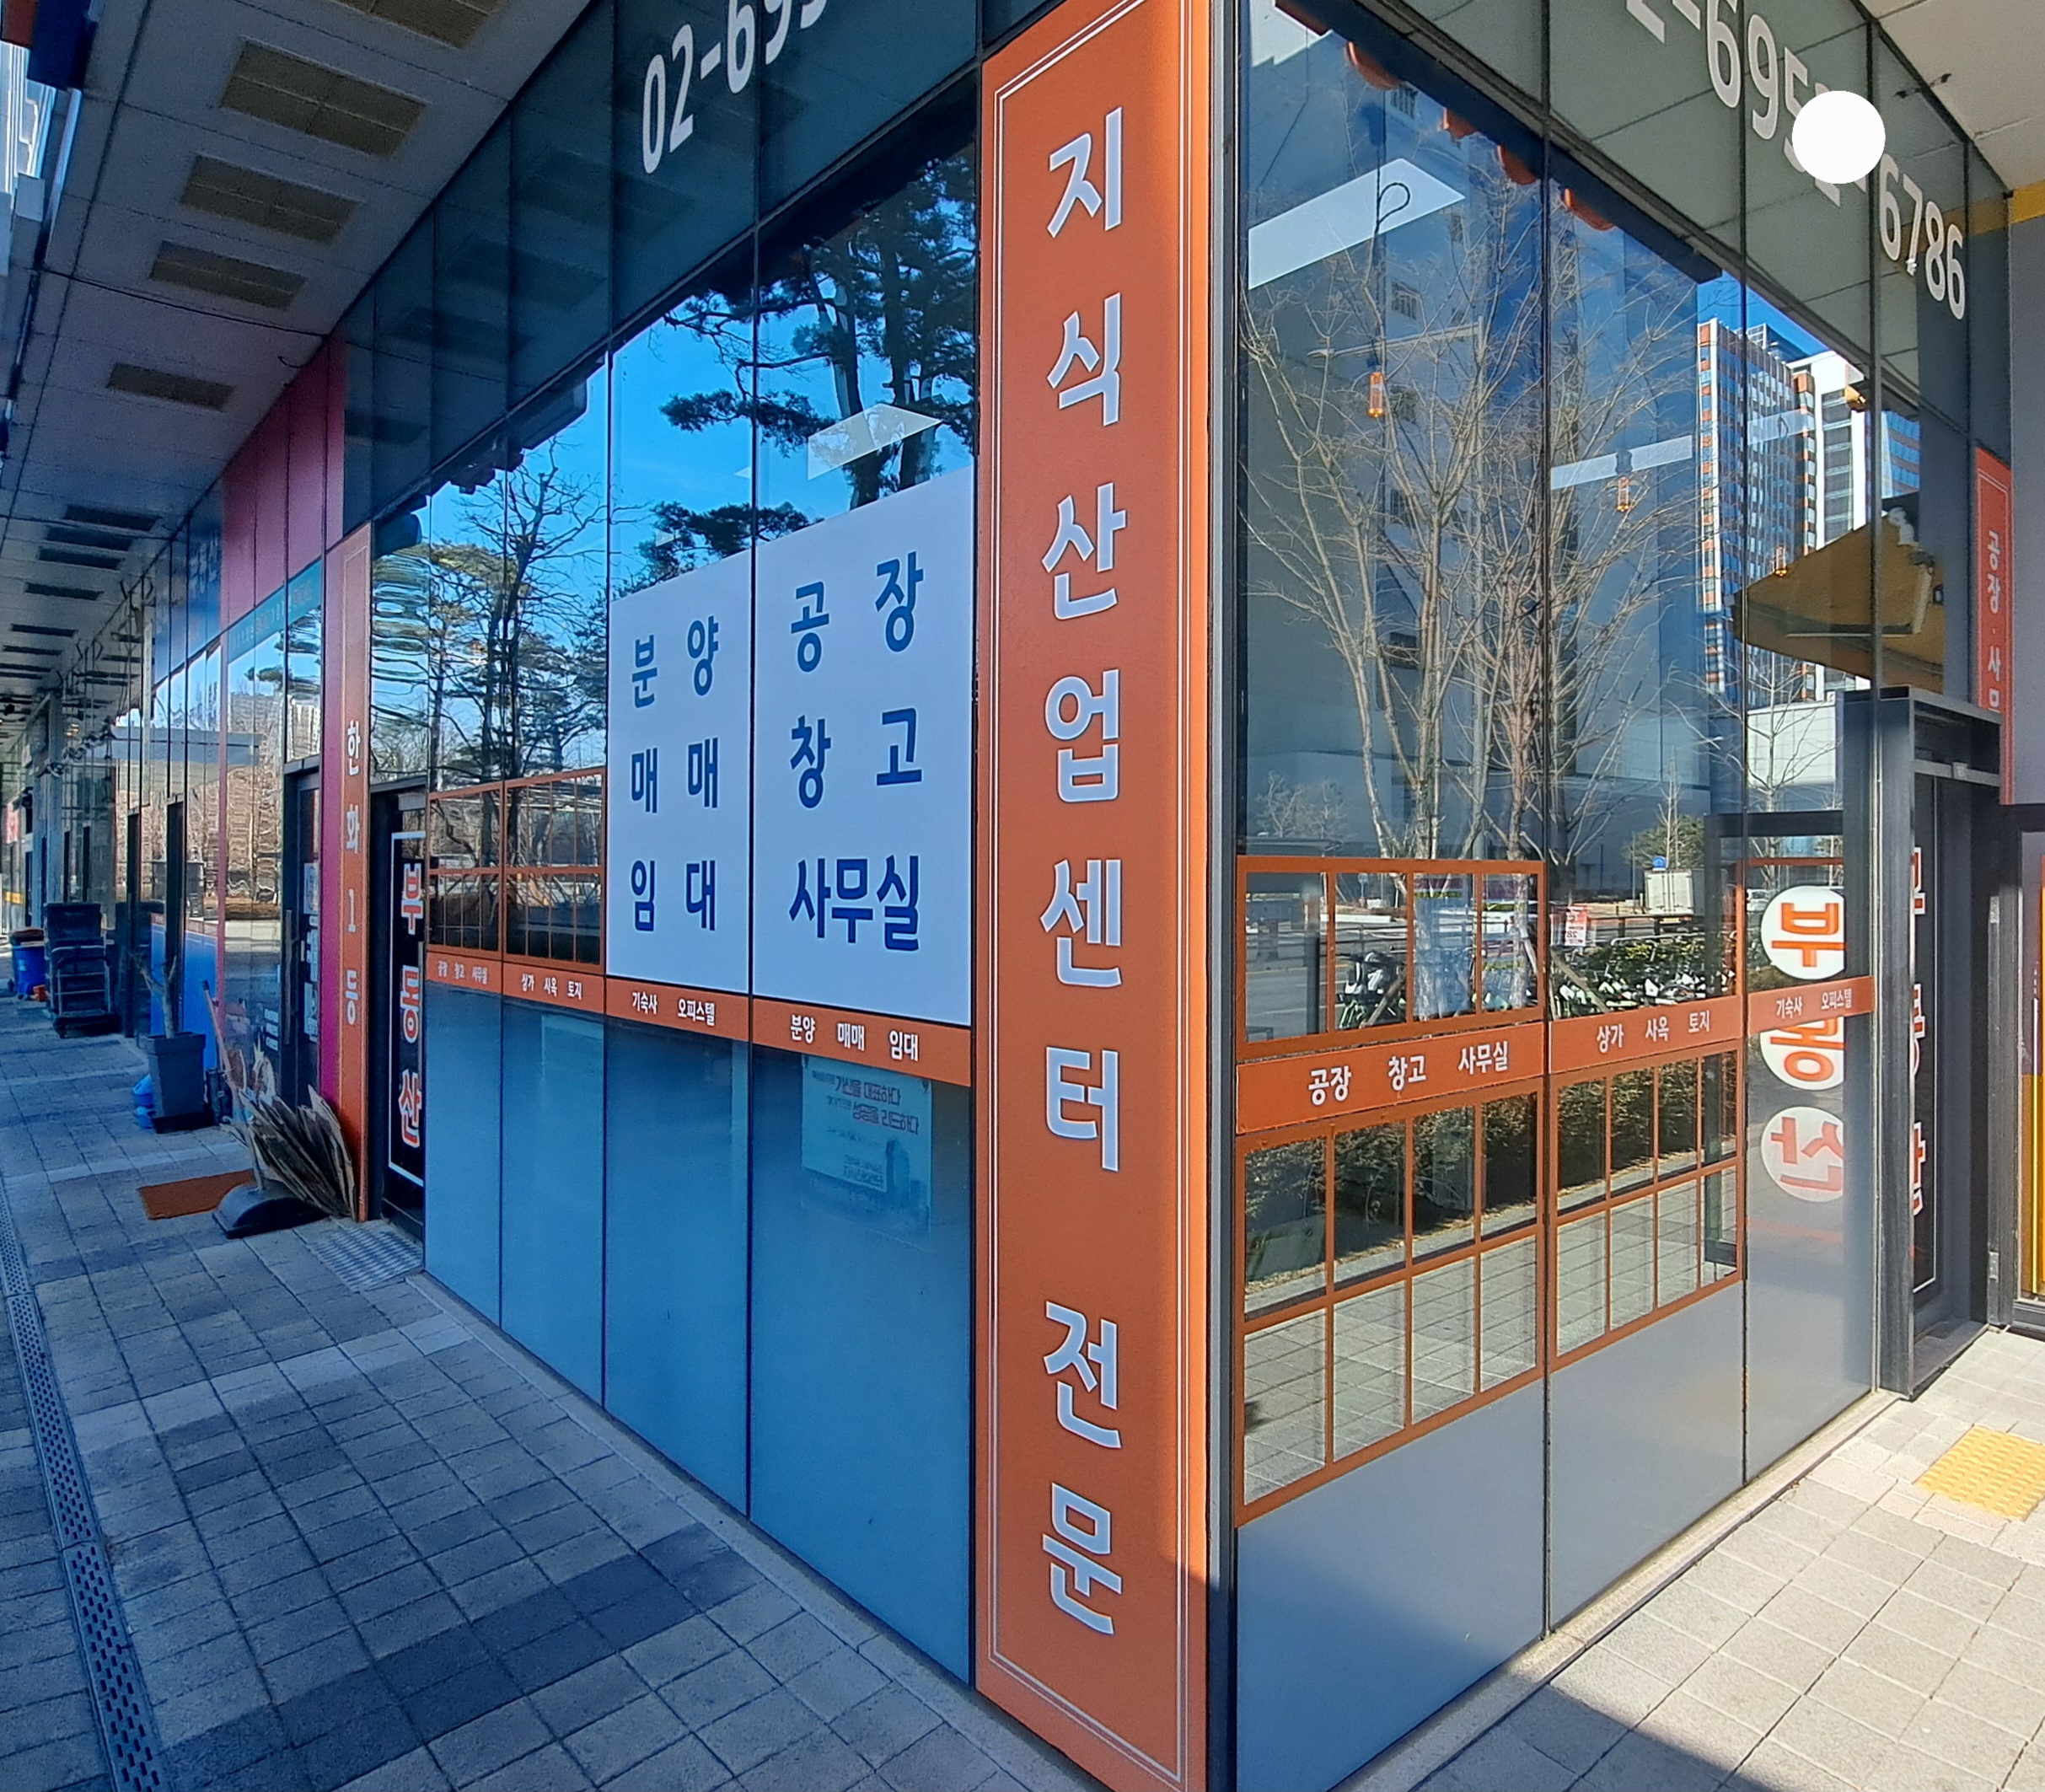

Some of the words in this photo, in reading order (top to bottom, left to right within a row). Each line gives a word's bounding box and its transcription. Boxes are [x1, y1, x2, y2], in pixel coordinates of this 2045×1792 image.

[642, 0, 828, 174] 02-69
[789, 550, 925, 673] 공장
[1039, 106, 1128, 1172] 지식산업센터
[631, 614, 720, 710] 분양
[630, 735, 720, 813] 매매
[789, 706, 925, 809] 창고
[630, 858, 717, 931] 임대
[789, 854, 921, 952] 사무실
[521, 973, 535, 993] 상가
[543, 976, 558, 997] 사옥
[566, 979, 583, 1001] 토지
[631, 991, 658, 1015] 기숙사
[677, 998, 715, 1027] 오피스텔
[1776, 995, 1803, 1019] 기숙사
[1821, 988, 1852, 1010] 오피스텔
[790, 1014, 816, 1044] 분양
[837, 1022, 865, 1051] 매매
[889, 1030, 919, 1061] 임대
[1596, 1023, 1624, 1054] 상가
[1645, 1016, 1670, 1042] 사옥
[1688, 1010, 1710, 1033] 토지
[1308, 1065, 1352, 1106] 공장
[1387, 1055, 1427, 1092] 창고
[1457, 1040, 1509, 1076] 사무실
[1042, 1301, 1123, 1636] 전문
